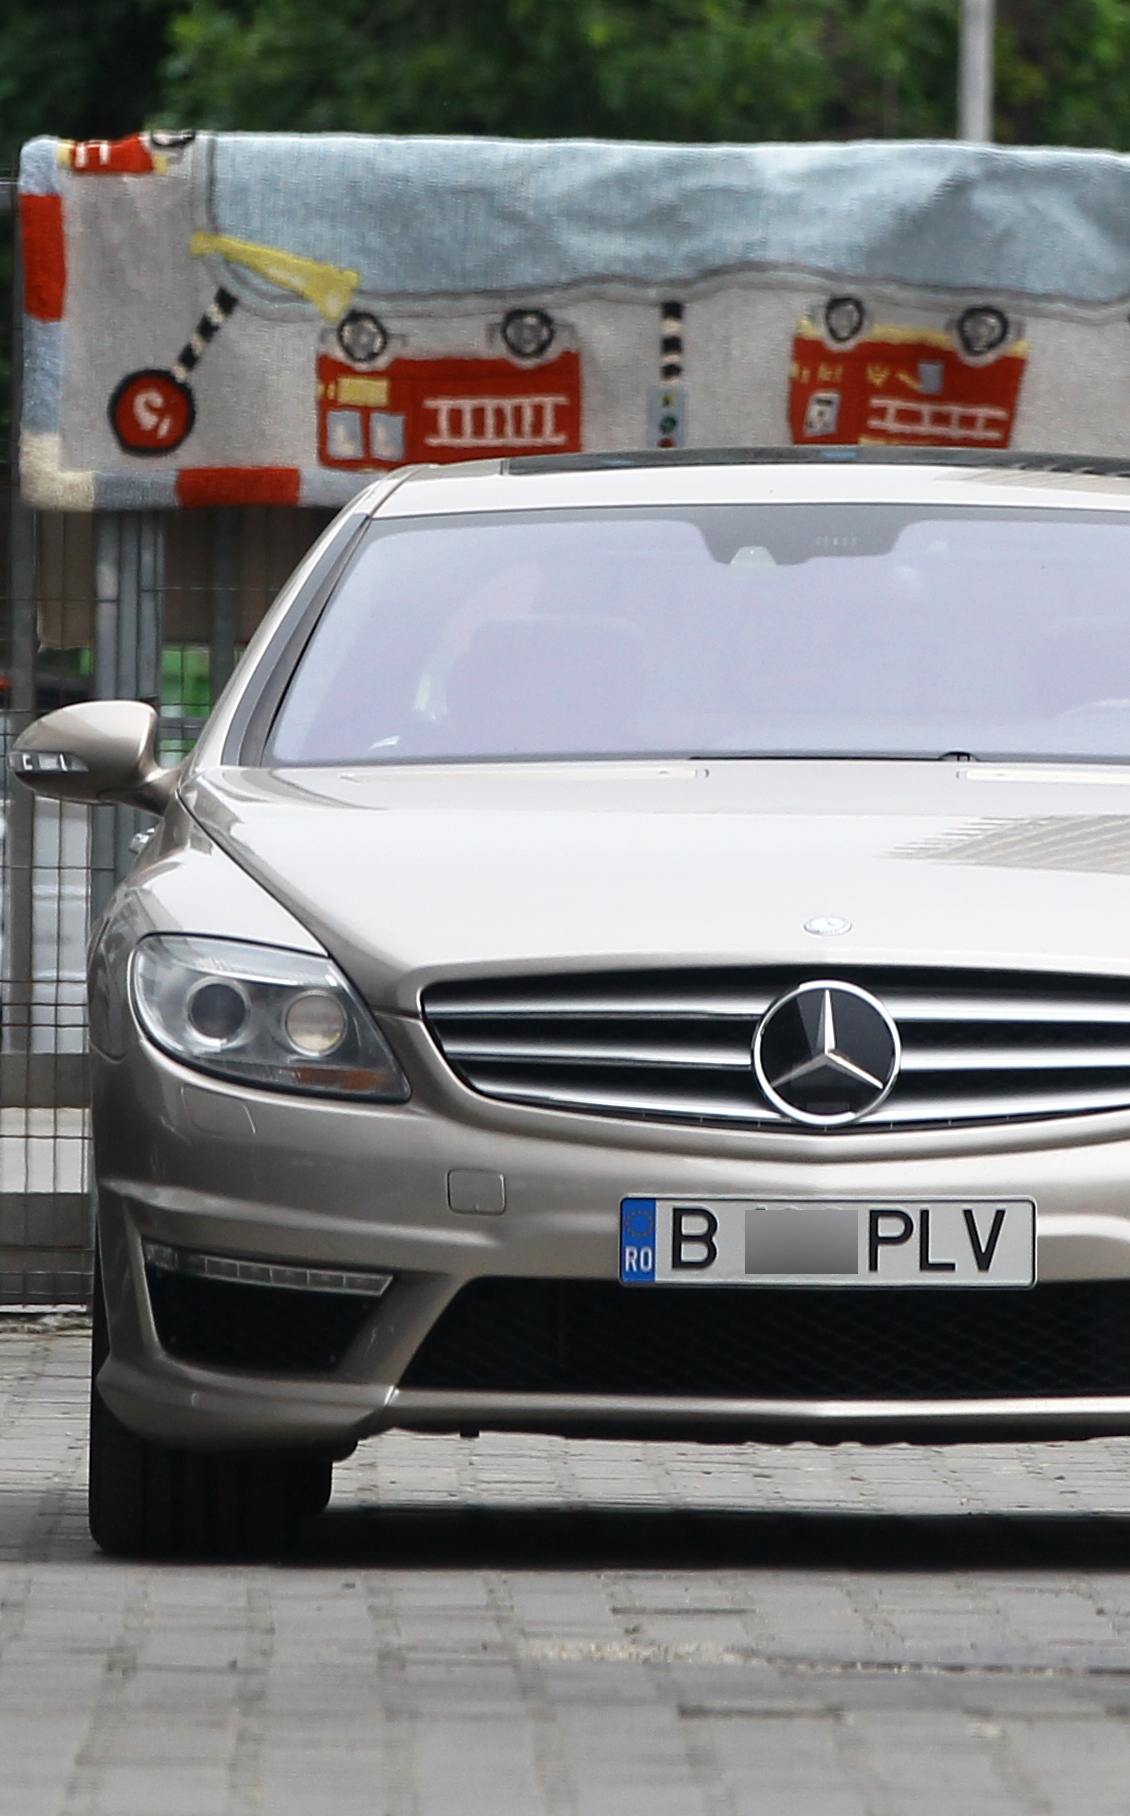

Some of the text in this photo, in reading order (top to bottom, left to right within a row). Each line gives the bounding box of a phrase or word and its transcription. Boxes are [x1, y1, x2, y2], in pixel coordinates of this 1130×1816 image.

[624, 1245, 653, 1273] RO
[671, 1206, 718, 1270] B
[868, 1208, 1006, 1272] PLV
